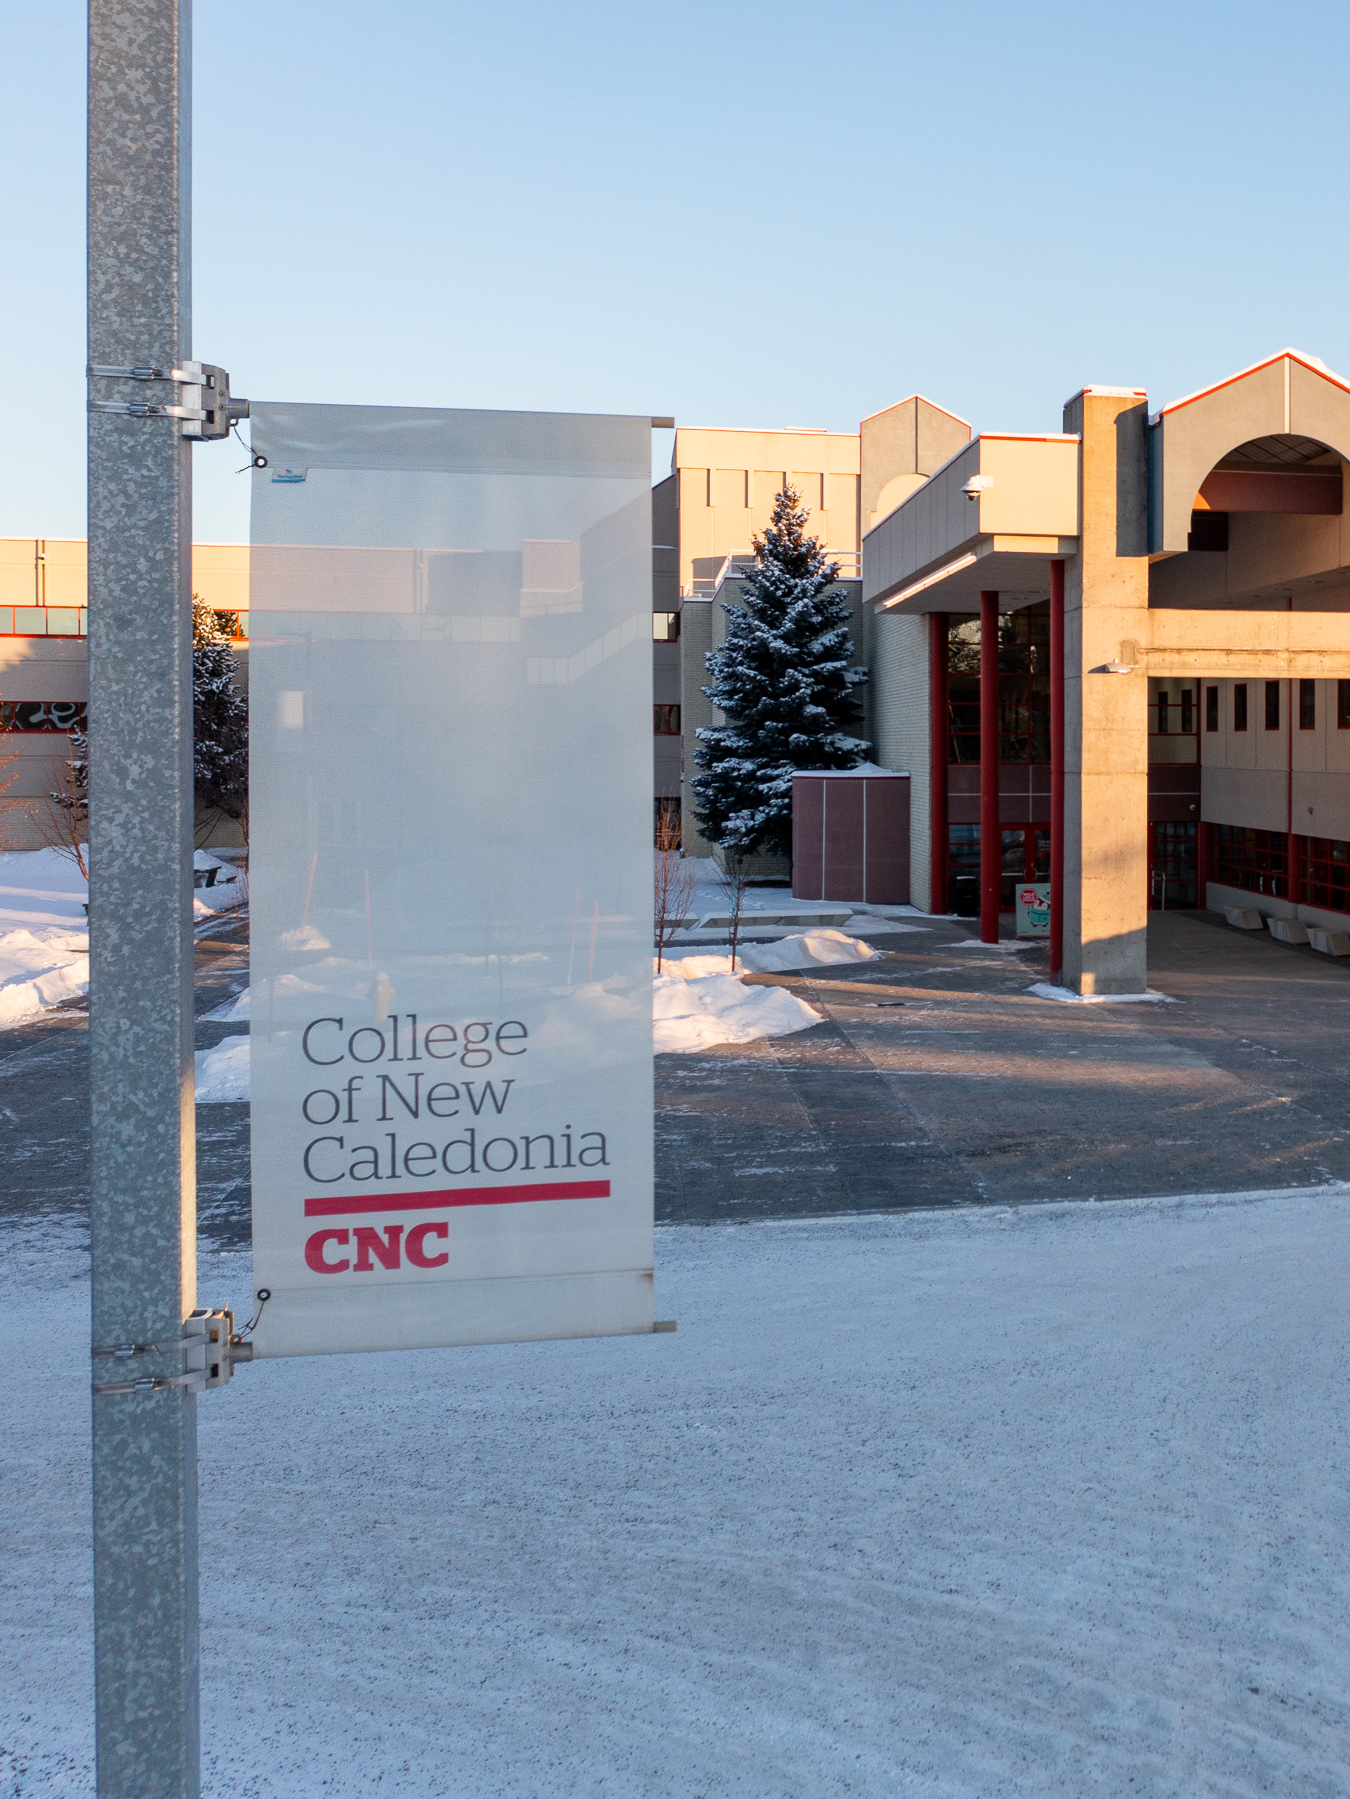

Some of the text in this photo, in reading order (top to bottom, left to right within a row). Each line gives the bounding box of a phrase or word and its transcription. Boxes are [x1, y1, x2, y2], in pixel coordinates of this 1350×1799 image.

[302, 1013, 528, 1068] College
[302, 1072, 515, 1125] of New
[303, 1124, 611, 1183] Caledonia
[304, 1221, 449, 1274] CNC
